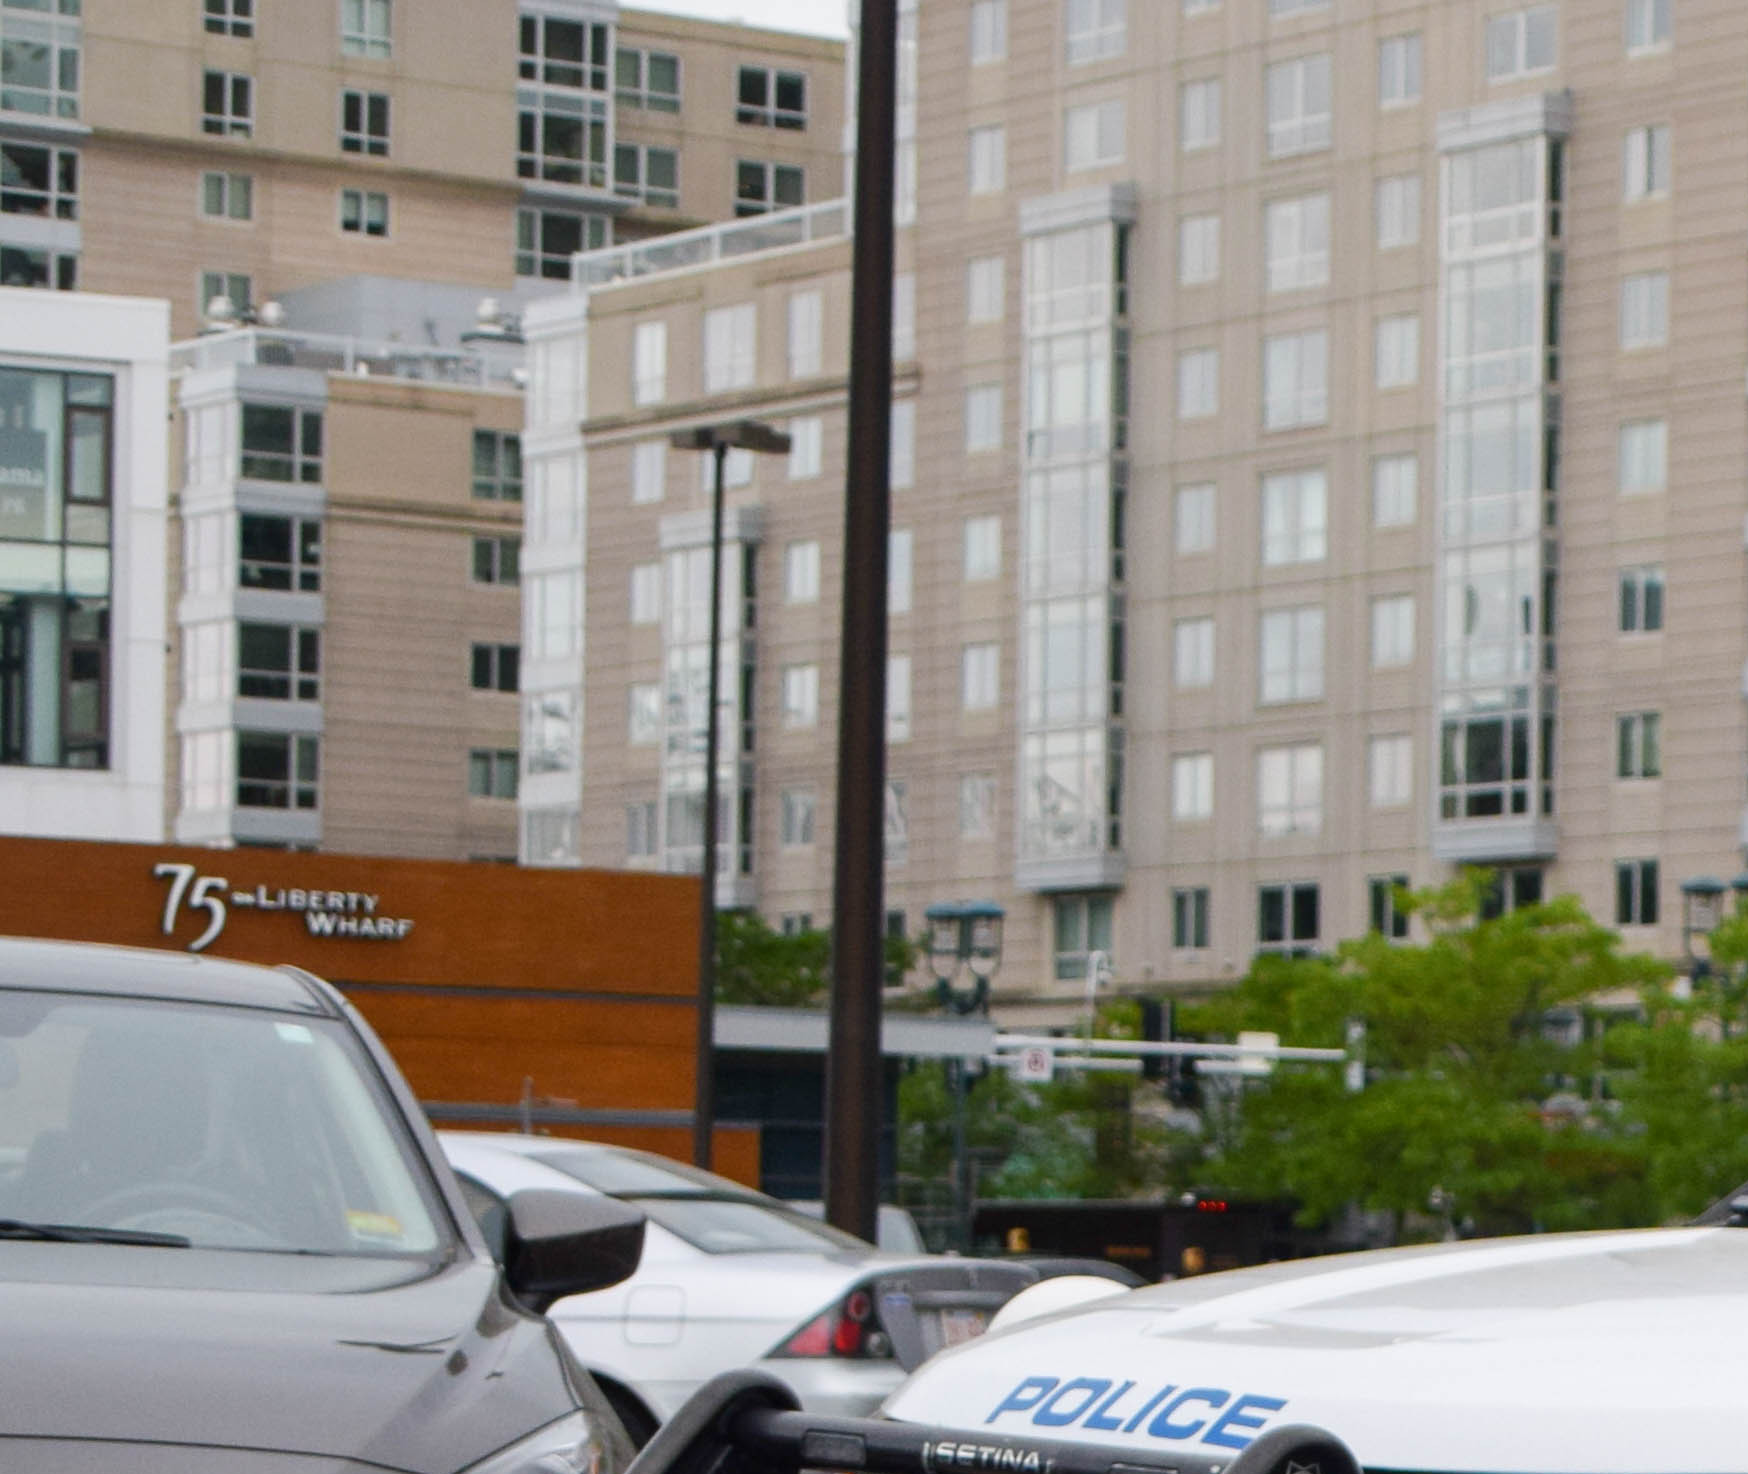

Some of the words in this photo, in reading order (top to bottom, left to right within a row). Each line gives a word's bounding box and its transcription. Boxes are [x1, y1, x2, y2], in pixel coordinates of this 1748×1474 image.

[153, 863, 228, 951] 75
[987, 1376, 1288, 1449] POLICE
[935, 1442, 1040, 1471] SETINA
